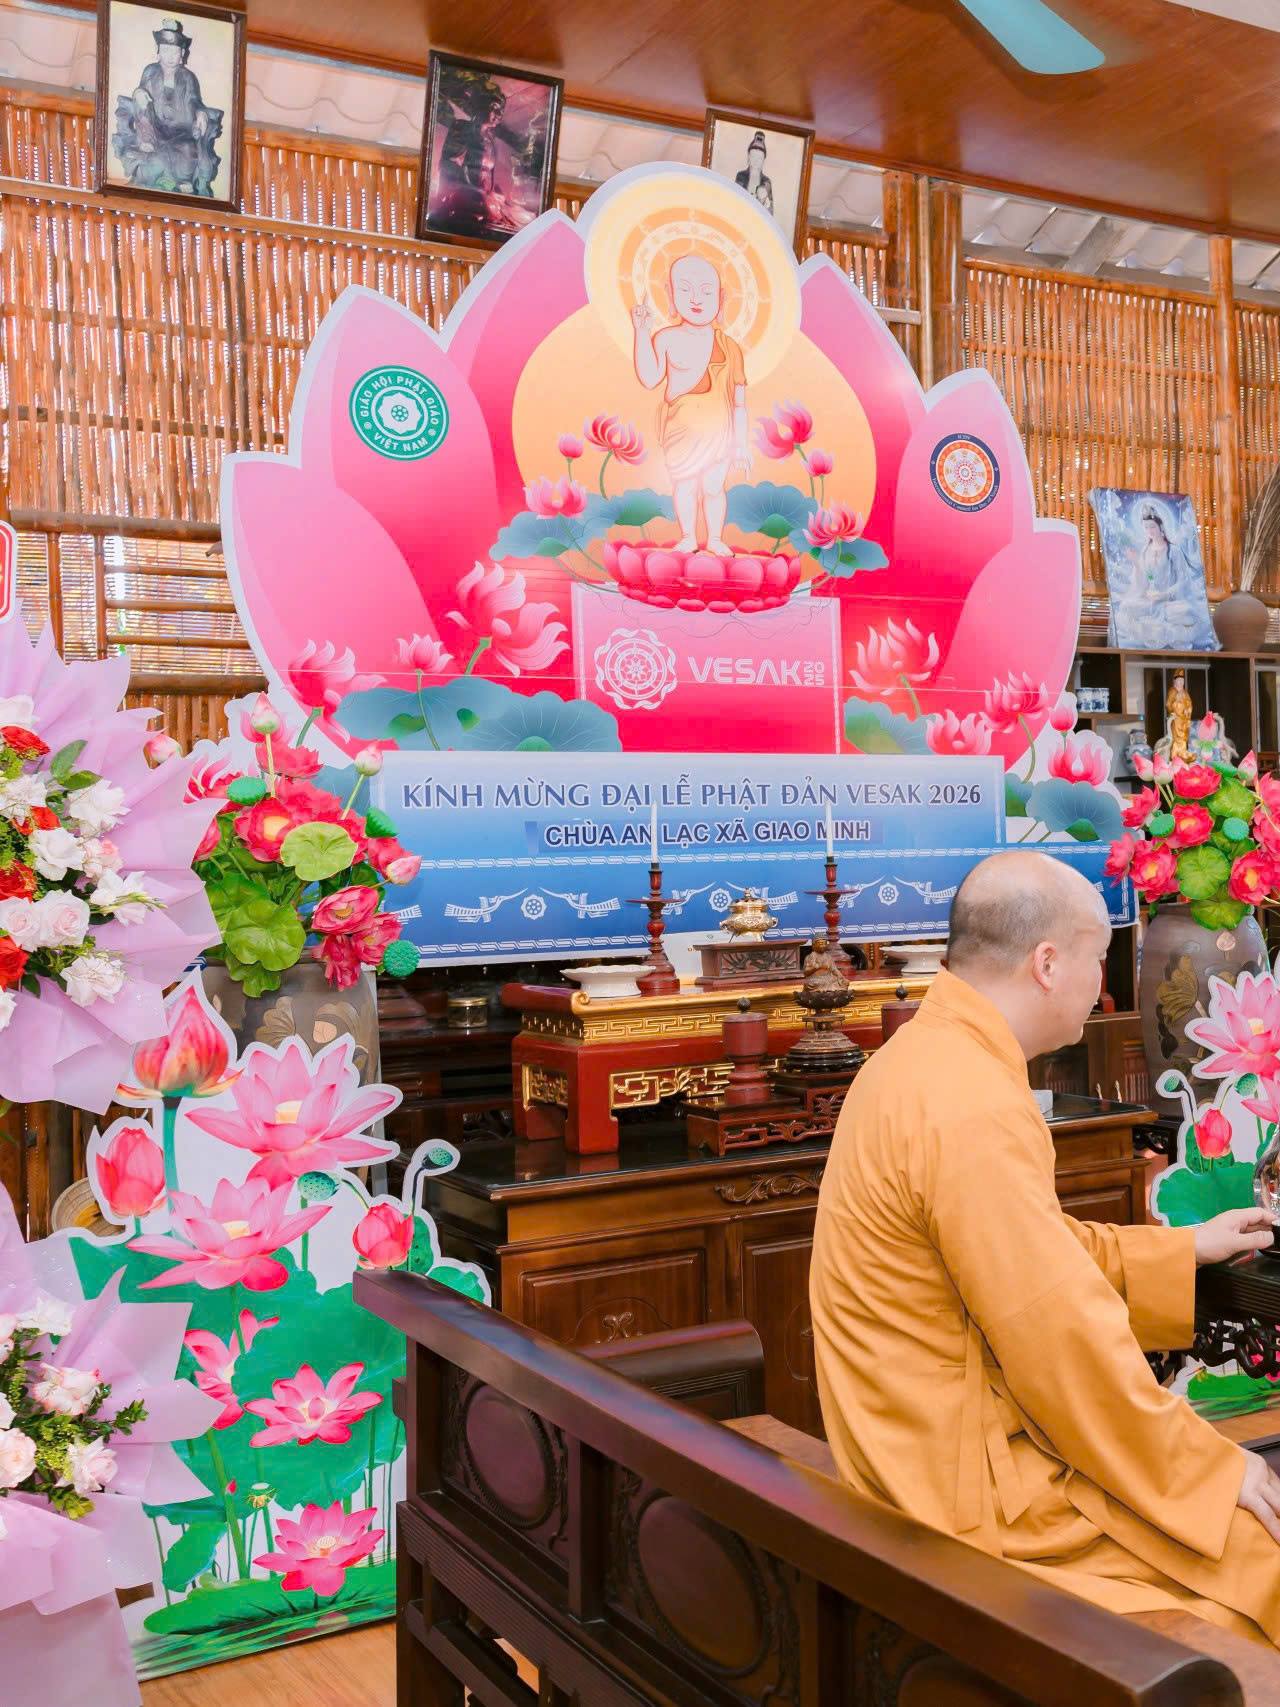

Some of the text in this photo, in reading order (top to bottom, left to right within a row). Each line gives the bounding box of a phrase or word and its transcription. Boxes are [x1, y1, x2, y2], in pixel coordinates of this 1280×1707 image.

[403, 438, 428, 451] NAM
[687, 656, 803, 686] VESAK
[803, 660, 825, 673] 20
[803, 673, 825, 686] 25
[402, 773, 982, 812] KÍNH MỪNG ĐẠI LỄ PHẬT ĐẢN VESAK 2026
[545, 820, 617, 846] CHÙA
[619, 824, 651, 846] AN
[661, 822, 709, 848] LẠC
[715, 818, 749, 842] XÃ
[754, 821, 811, 841] GIAO
